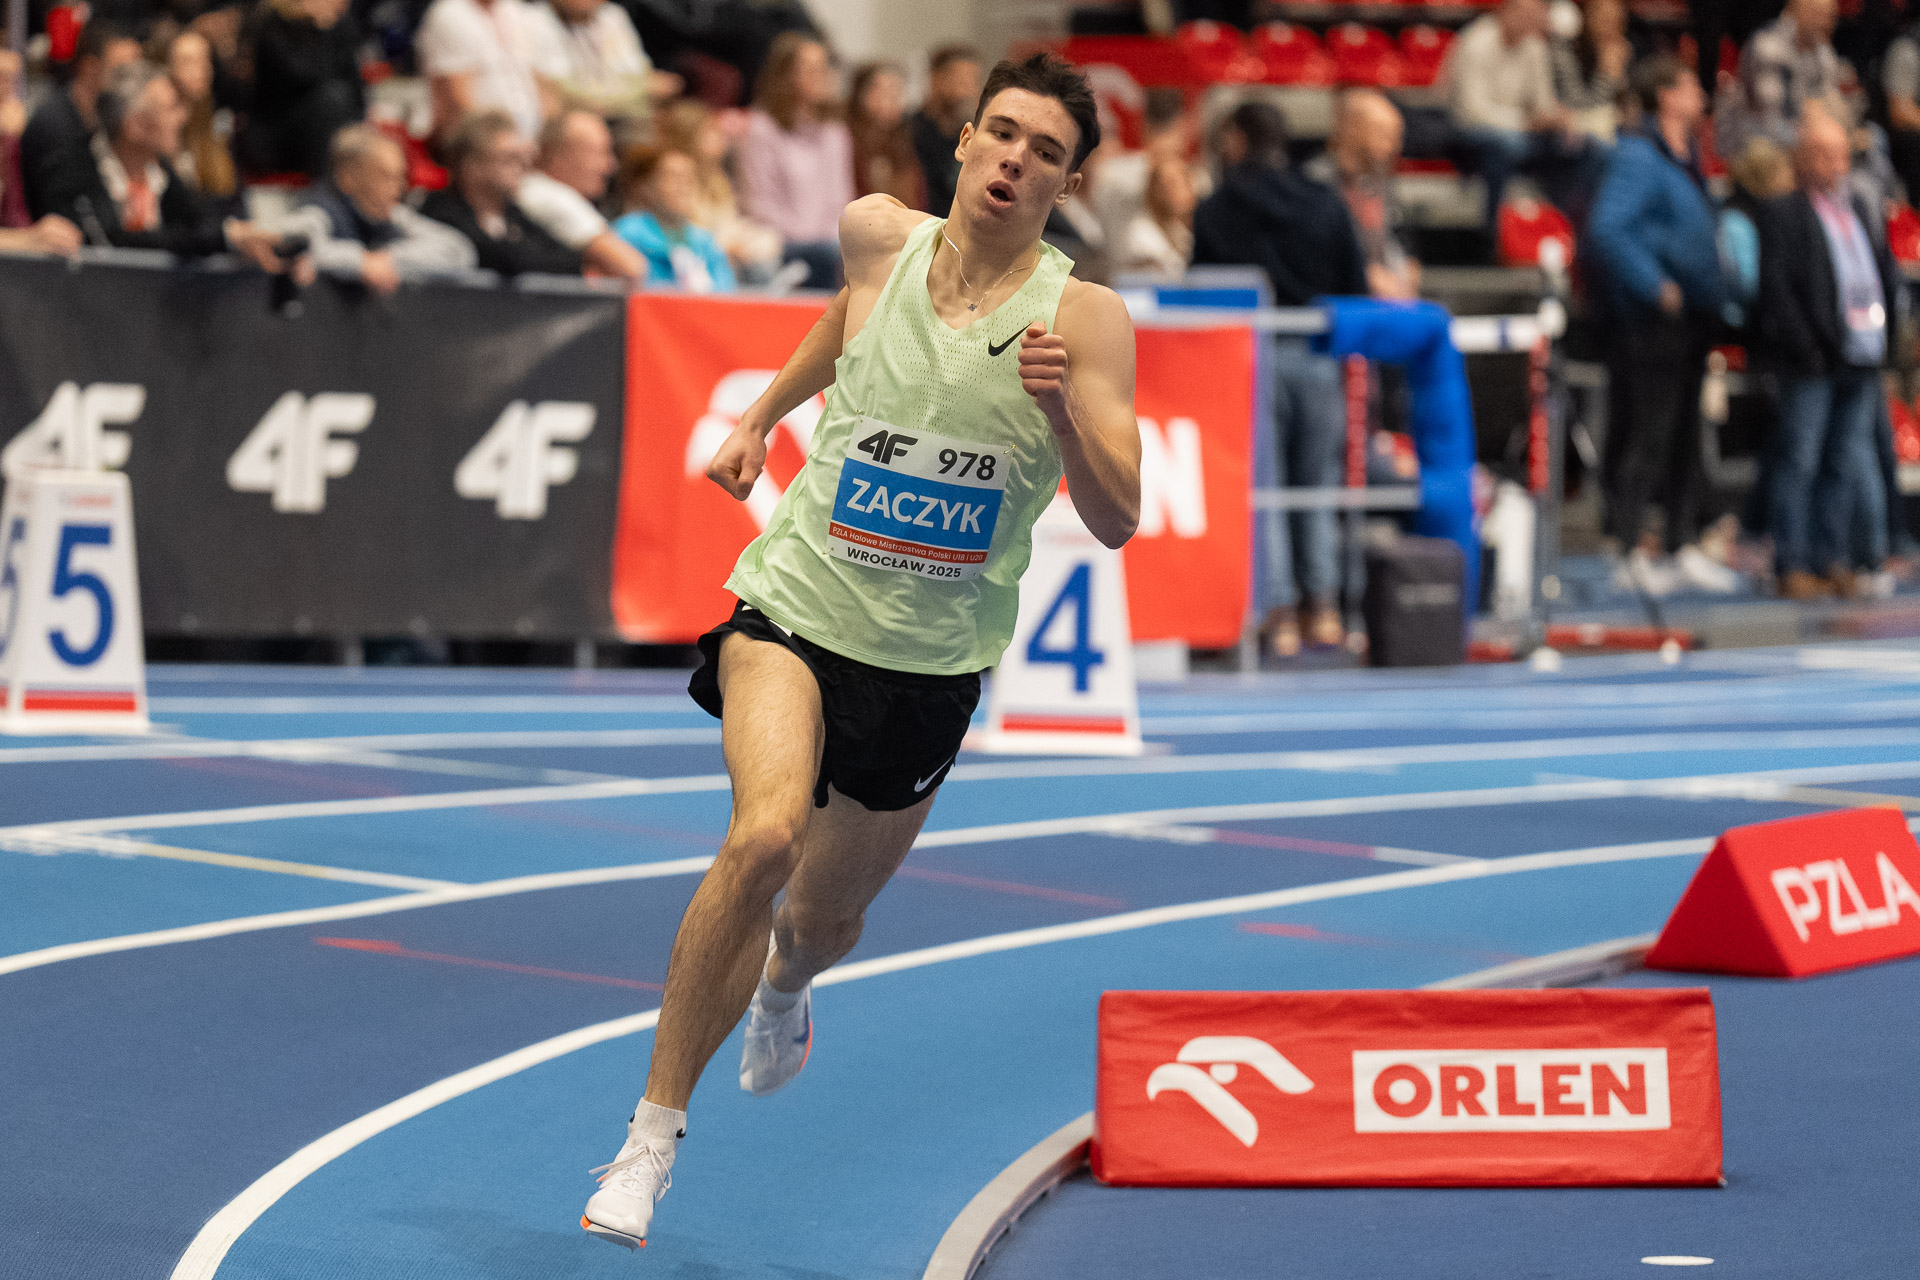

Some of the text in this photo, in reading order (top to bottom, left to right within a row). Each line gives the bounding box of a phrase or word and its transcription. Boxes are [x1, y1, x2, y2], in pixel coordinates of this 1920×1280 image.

[226, 390, 376, 514] 4F
[453, 399, 598, 521] 4F
[857, 429, 919, 465] 4F
[937, 448, 997, 481] 978
[846, 477, 987, 534] ZACZYK
[832, 526, 848, 538] PZLA
[849, 531, 878, 546] Halowe
[878, 540, 927, 556] Mistrzostwa
[928, 550, 952, 561] Polski
[952, 553, 965, 561] U18
[969, 554, 984, 562] U20
[847, 546, 962, 578] WROCŁAW 2025
[48, 521, 116, 668] 5
[1025, 560, 1106, 693] 4
[1770, 851, 1920, 943] PZLA
[1372, 1062, 1648, 1118] ORLEN
